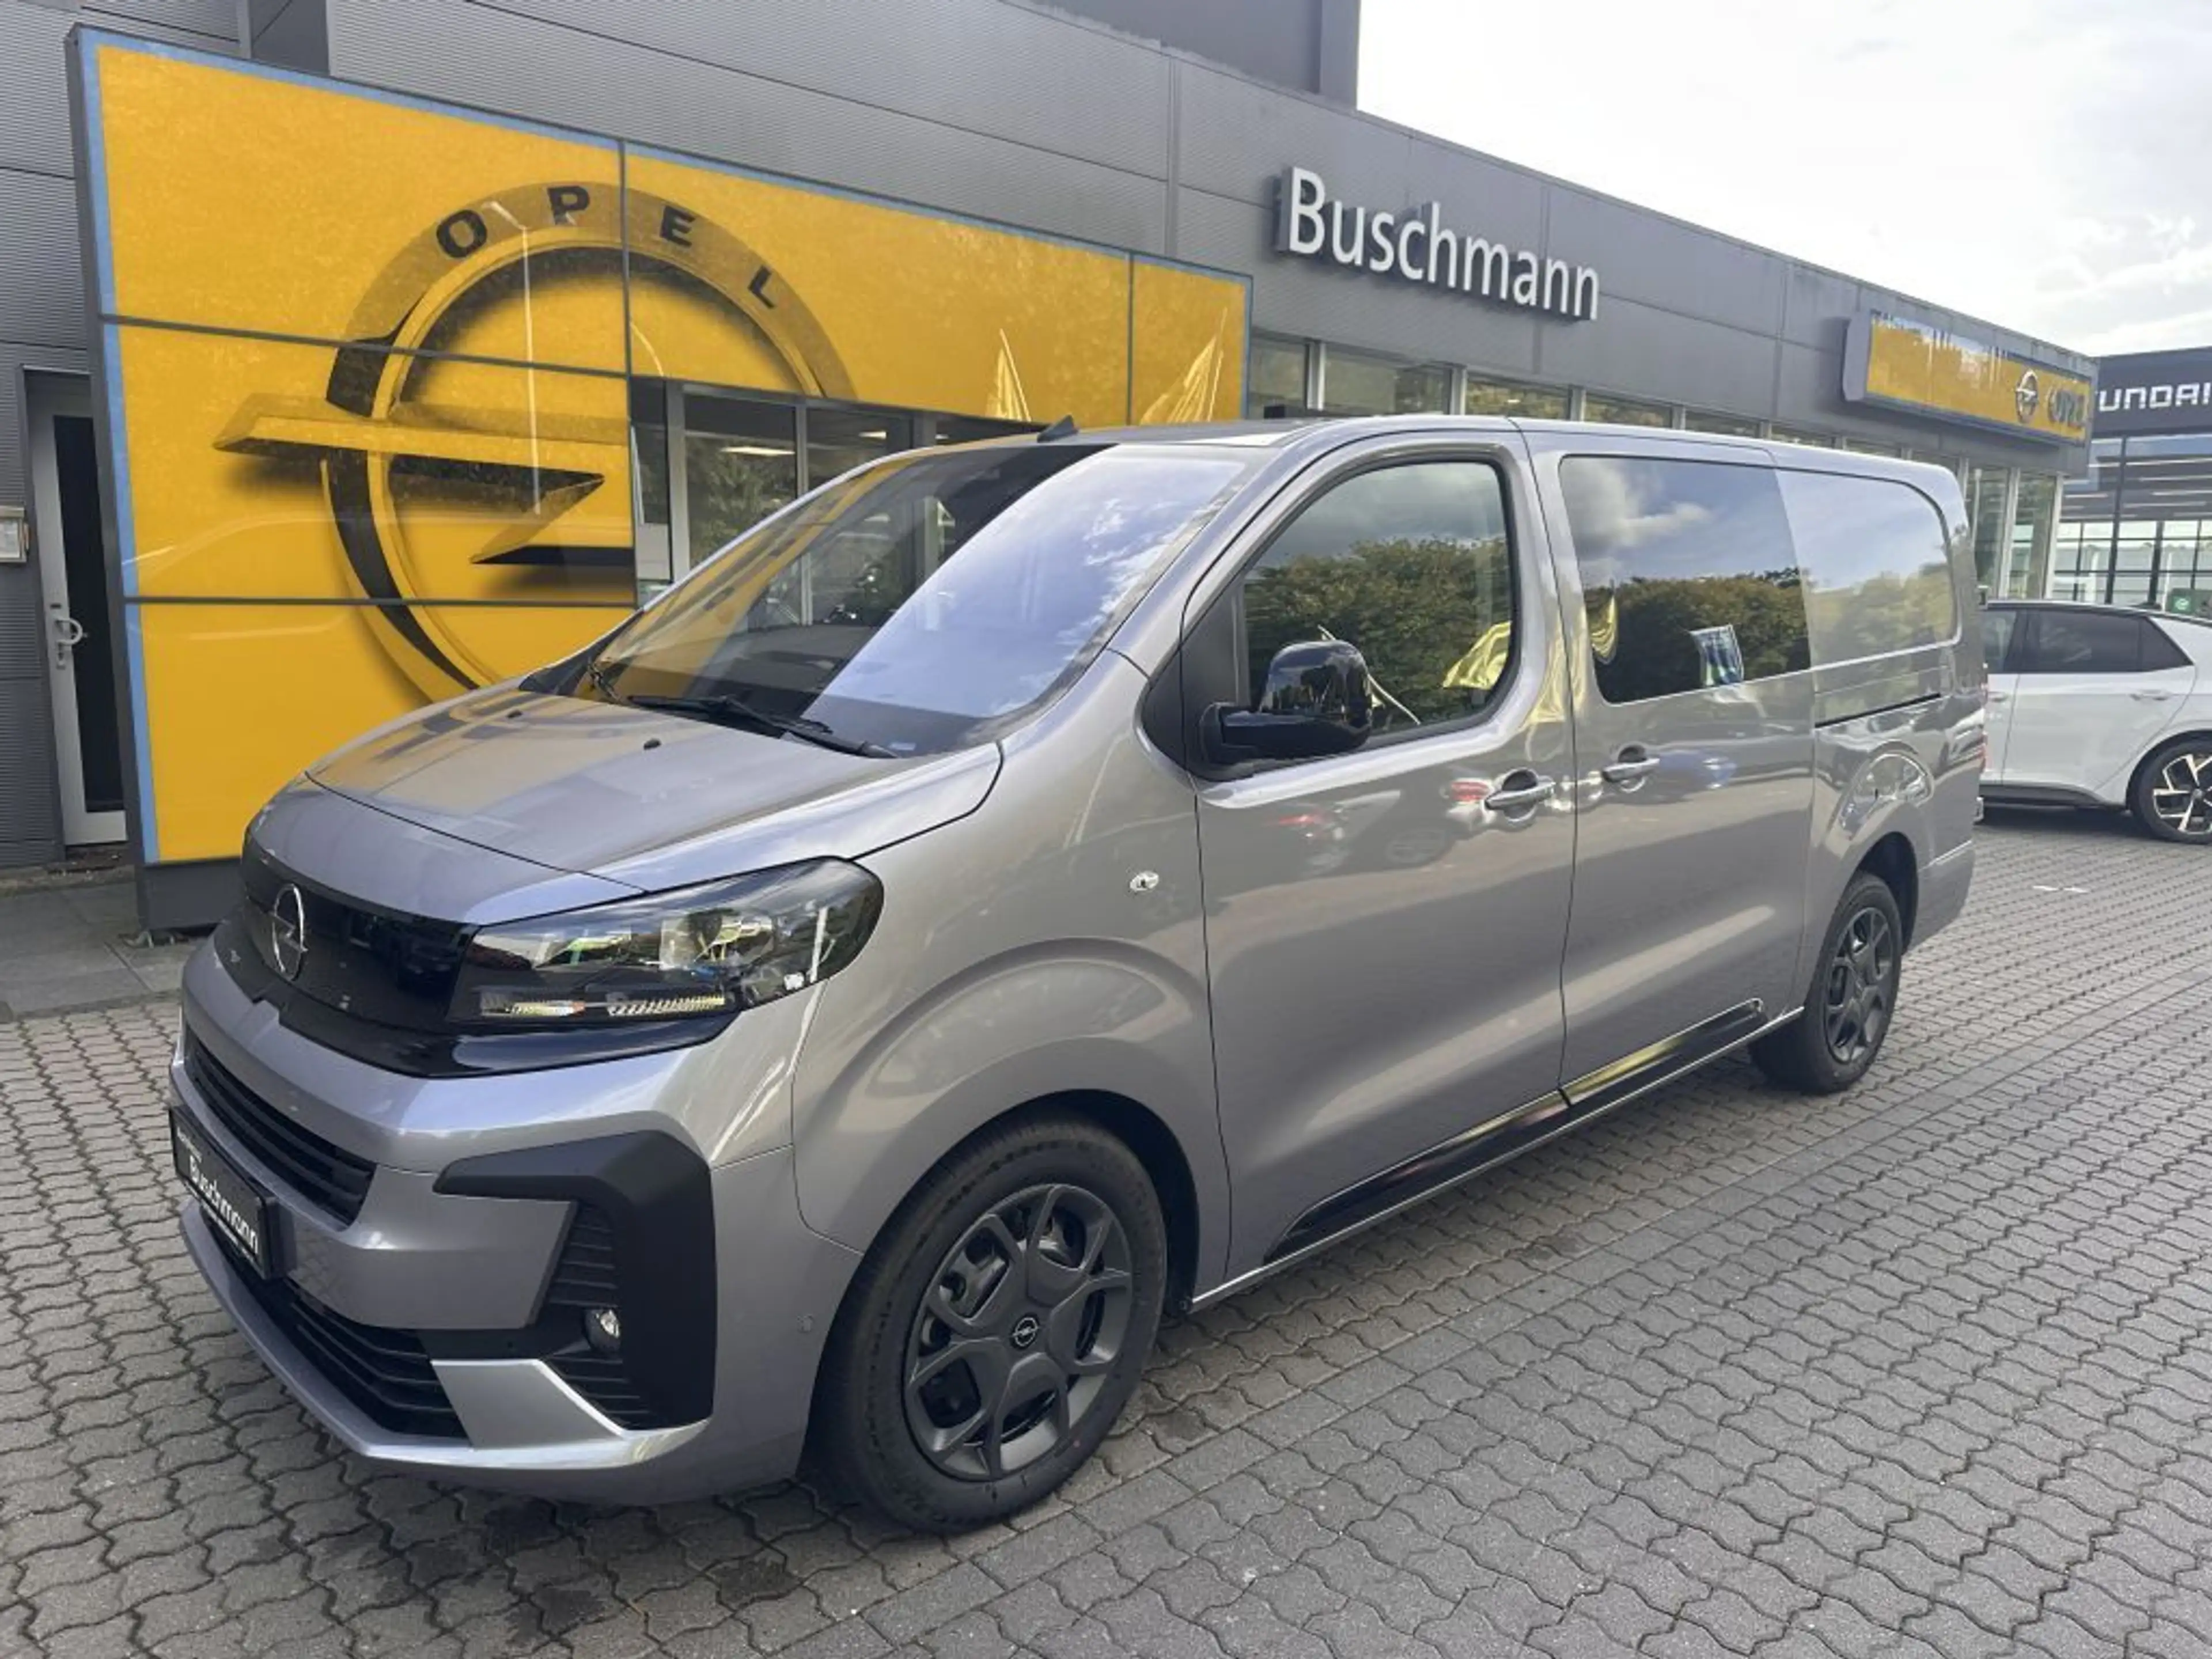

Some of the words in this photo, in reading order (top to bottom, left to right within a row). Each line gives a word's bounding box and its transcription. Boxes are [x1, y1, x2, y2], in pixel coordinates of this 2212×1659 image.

[436, 185, 787, 308] OPEL
[1289, 166, 1600, 321] Buschmann
[2095, 382, 2211, 411] UNDAI
[190, 1154, 259, 1255] Bchmann
